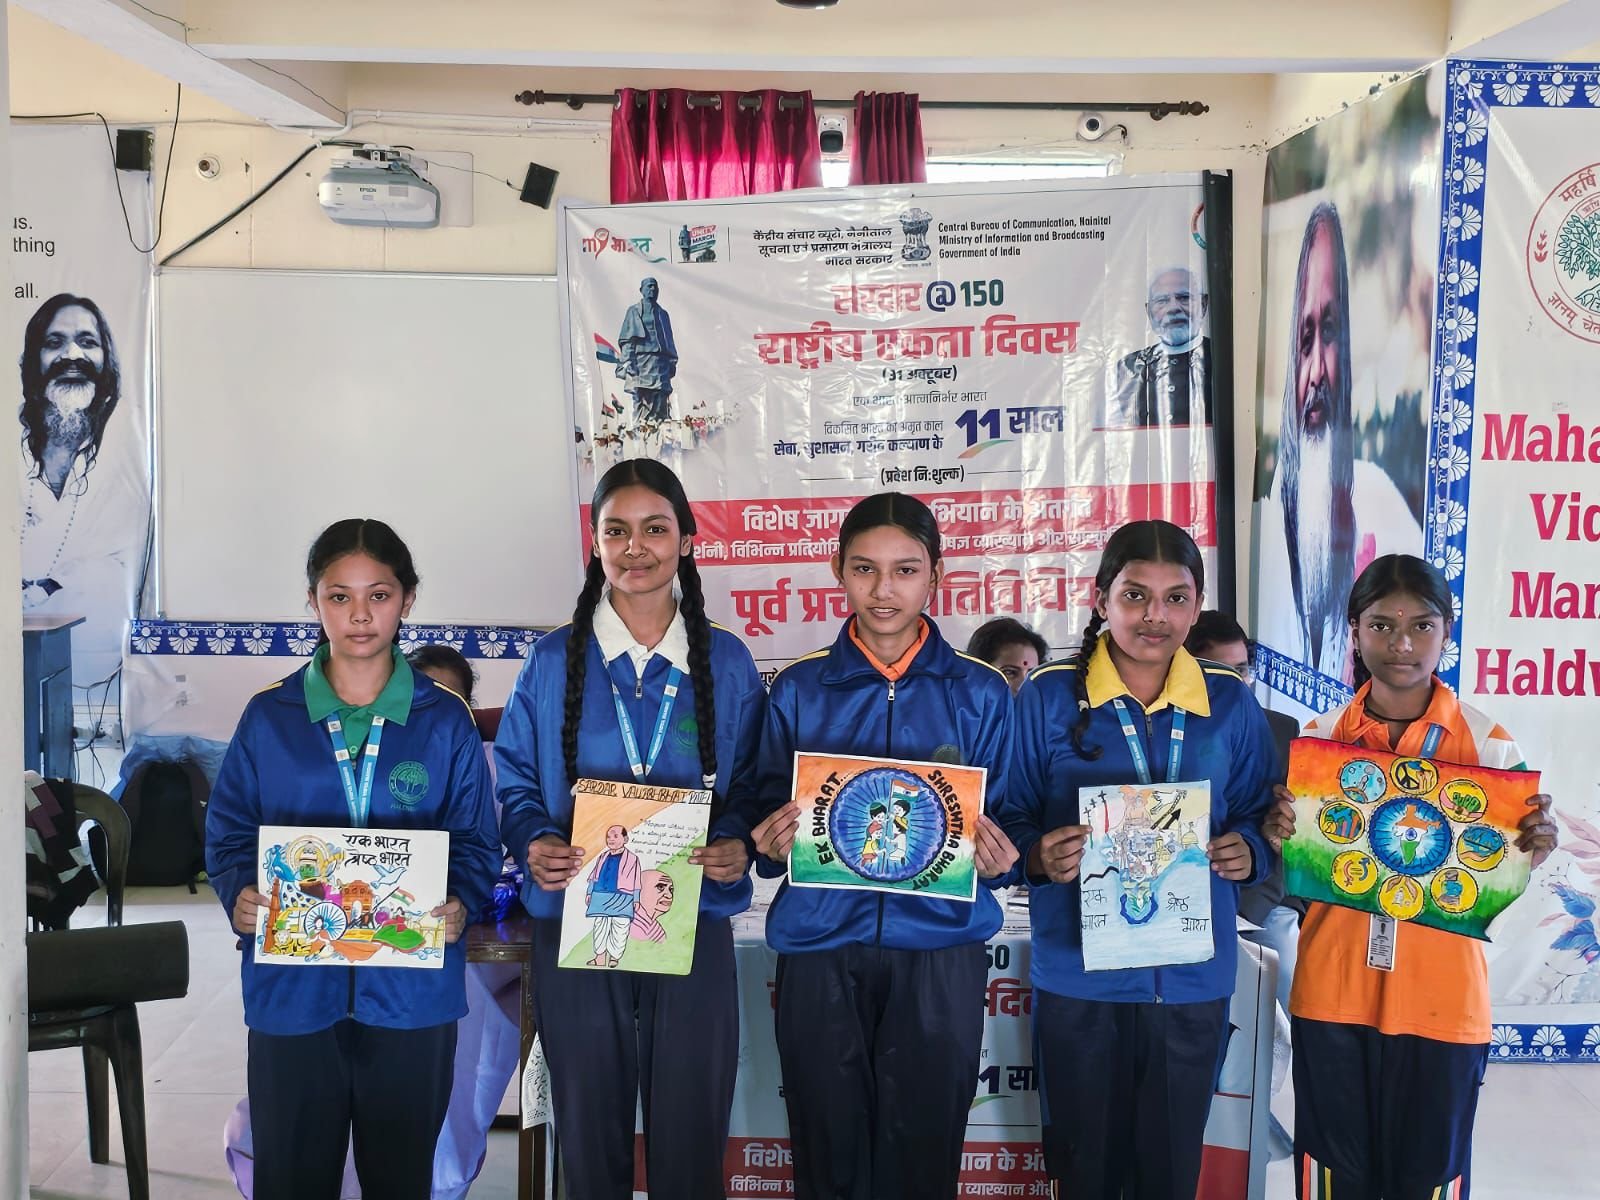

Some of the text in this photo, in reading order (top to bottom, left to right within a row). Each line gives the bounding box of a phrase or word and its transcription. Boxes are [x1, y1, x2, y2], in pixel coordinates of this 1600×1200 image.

[938, 215, 1111, 233] Central Bureau of Communication, Nainital
[692, 233, 715, 244] MARCH
[787, 229, 815, 240] संचार
[846, 226, 892, 238] नैनीताल
[939, 230, 1105, 246] Ministry of Information and Broadcasting
[13, 237, 55, 257] thing
[758, 244, 789, 257] सूचना
[811, 242, 849, 253] प्रसारण
[851, 240, 892, 251] मंत्रालय
[939, 246, 1021, 259] Government of India
[825, 256, 852, 266] भारत
[855, 254, 893, 265] सरकार
[15, 283, 38, 299] all.
[754, 314, 1081, 369] राष्ट्रीय एकता दिवस
[960, 390, 987, 402] भारत
[923, 420, 943, 432] काल
[1007, 405, 1066, 434] साल
[887, 438, 929, 451] कल्याण
[932, 434, 943, 450] के
[742, 505, 800, 532] विशेष
[932, 499, 998, 524] भियान
[693, 540, 728, 560] र्शनी,
[730, 539, 785, 558] विभिन्न
[730, 577, 791, 637] पूर्व
[1473, 647, 1600, 697] Hald
[913, 769, 963, 891] SHRESHTHA BHARAT
[374, 835, 412, 852] भारत
[379, 851, 413, 867] भारत
[816, 841, 835, 866] EK
[996, 1147, 1019, 1172] के
[729, 1175, 783, 1192] विभिन्न
[965, 1182, 1026, 1196] व्याख्यान
